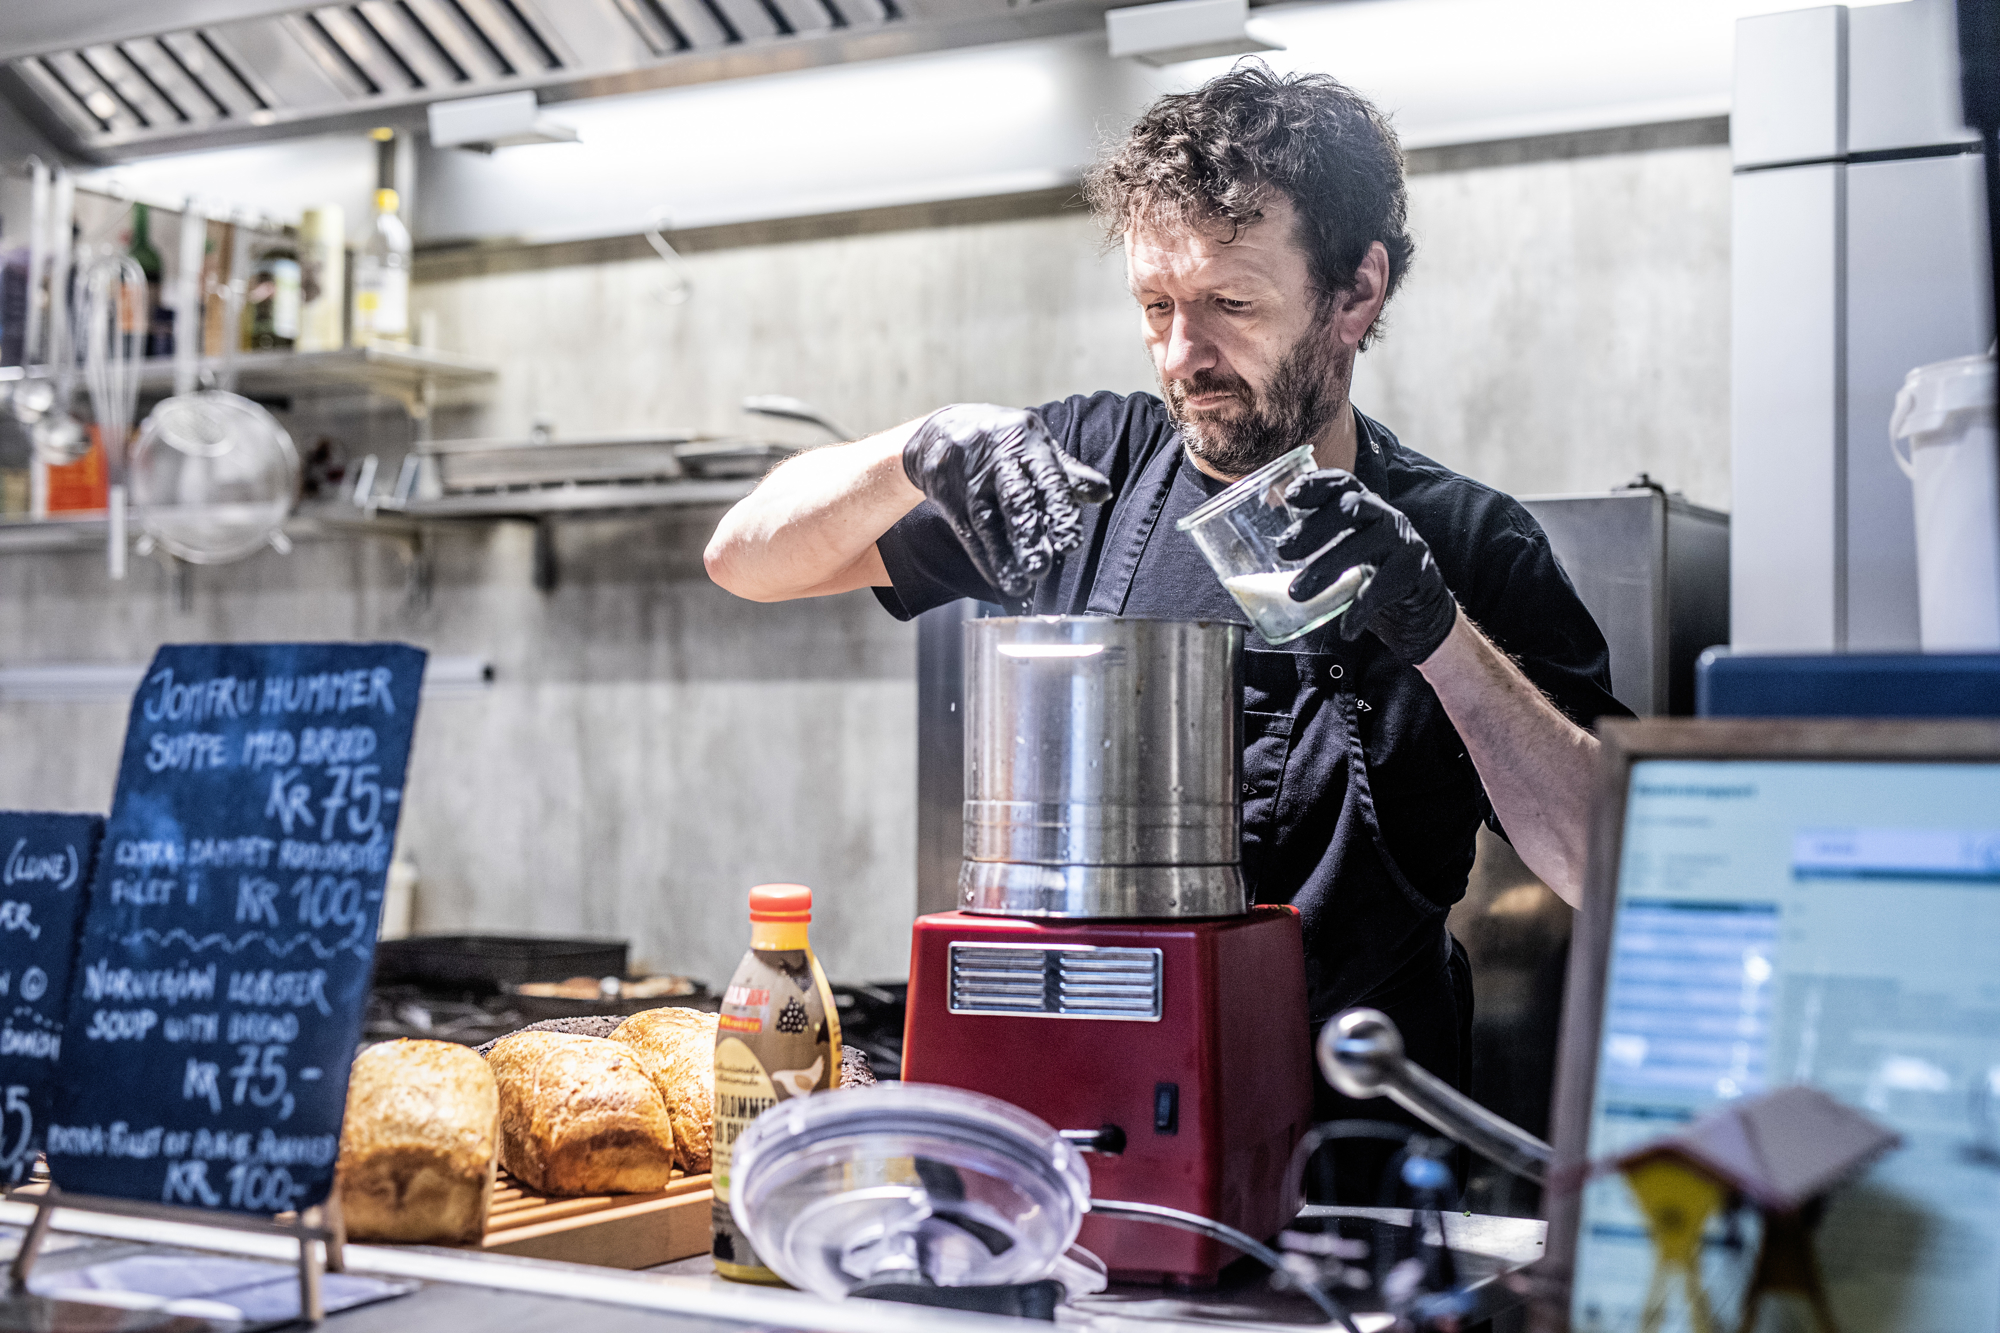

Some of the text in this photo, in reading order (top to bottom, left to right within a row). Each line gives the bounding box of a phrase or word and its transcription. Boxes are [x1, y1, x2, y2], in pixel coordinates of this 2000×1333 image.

[144, 666, 396, 722] JOMFRU HUMMER
[146, 731, 227, 773] SUPPE
[241, 729, 297, 773] MED
[235, 874, 280, 929] KR
[227, 968, 333, 1017] LOBSTER
[86, 1008, 158, 1042] SOUP
[182, 1056, 222, 1114] KR
[161, 1159, 222, 1206] KR
